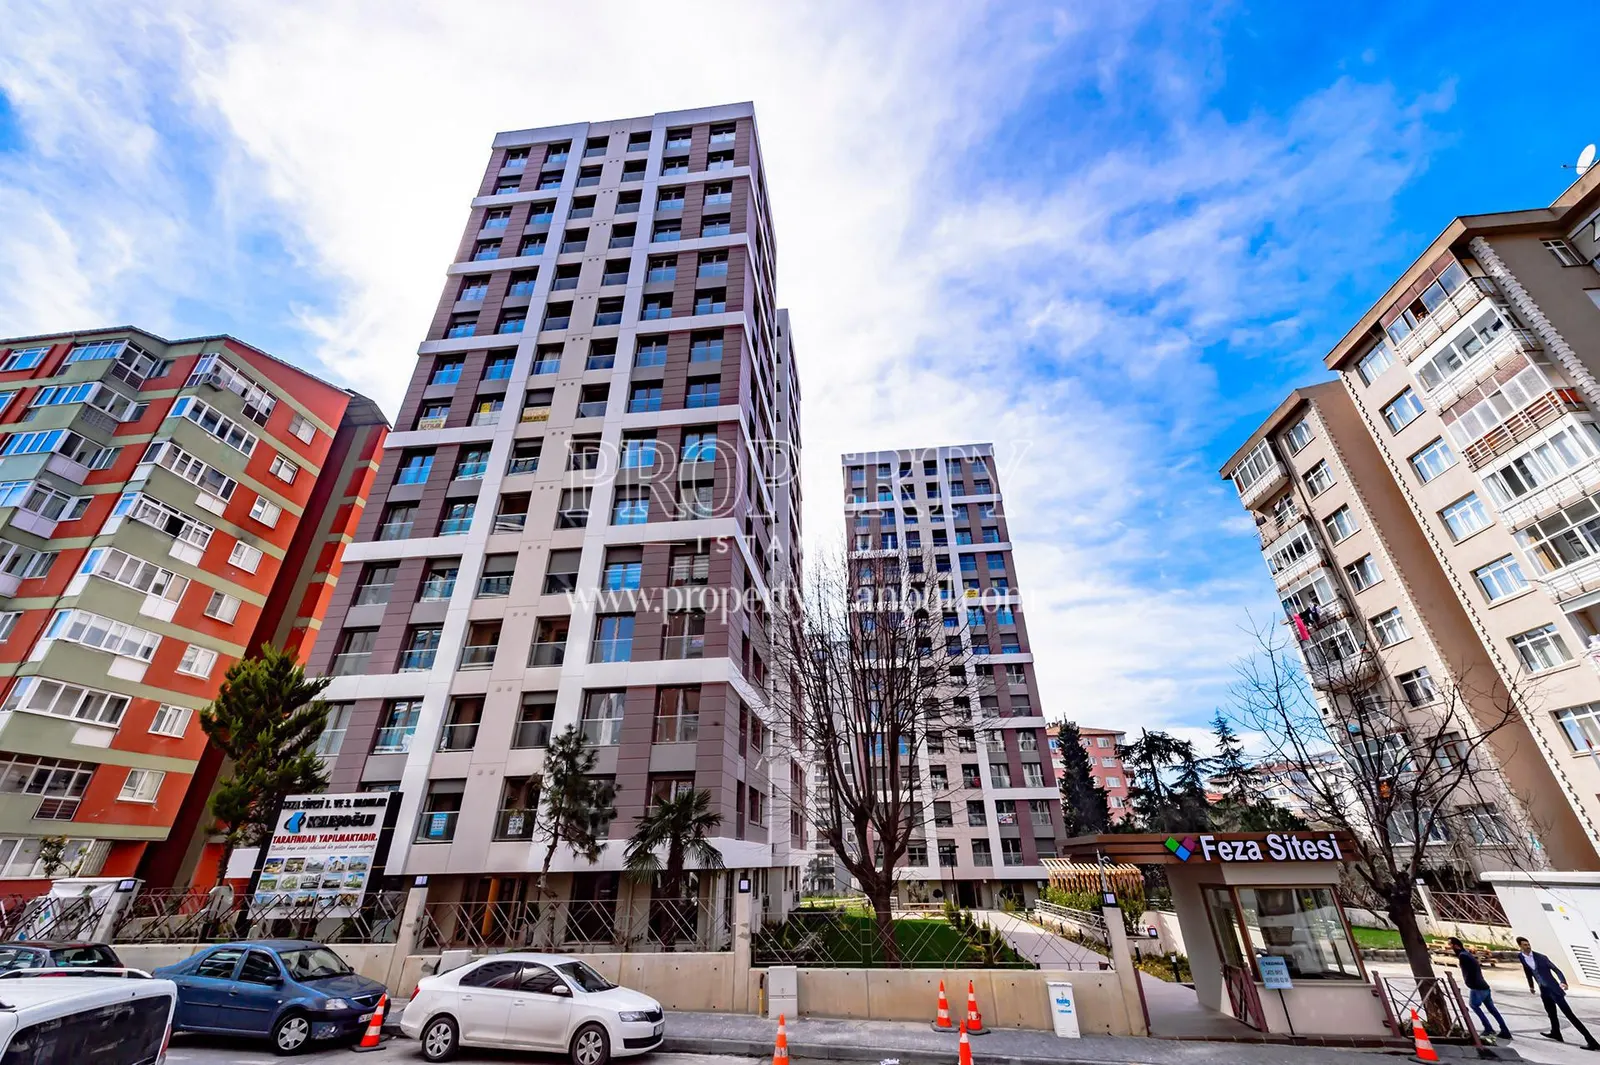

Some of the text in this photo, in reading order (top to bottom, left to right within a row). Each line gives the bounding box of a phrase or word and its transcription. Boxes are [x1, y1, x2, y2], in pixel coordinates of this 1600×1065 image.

[272, 836, 317, 845] TARAFINDAN
[1200, 833, 1343, 861] Feza Sitesi
